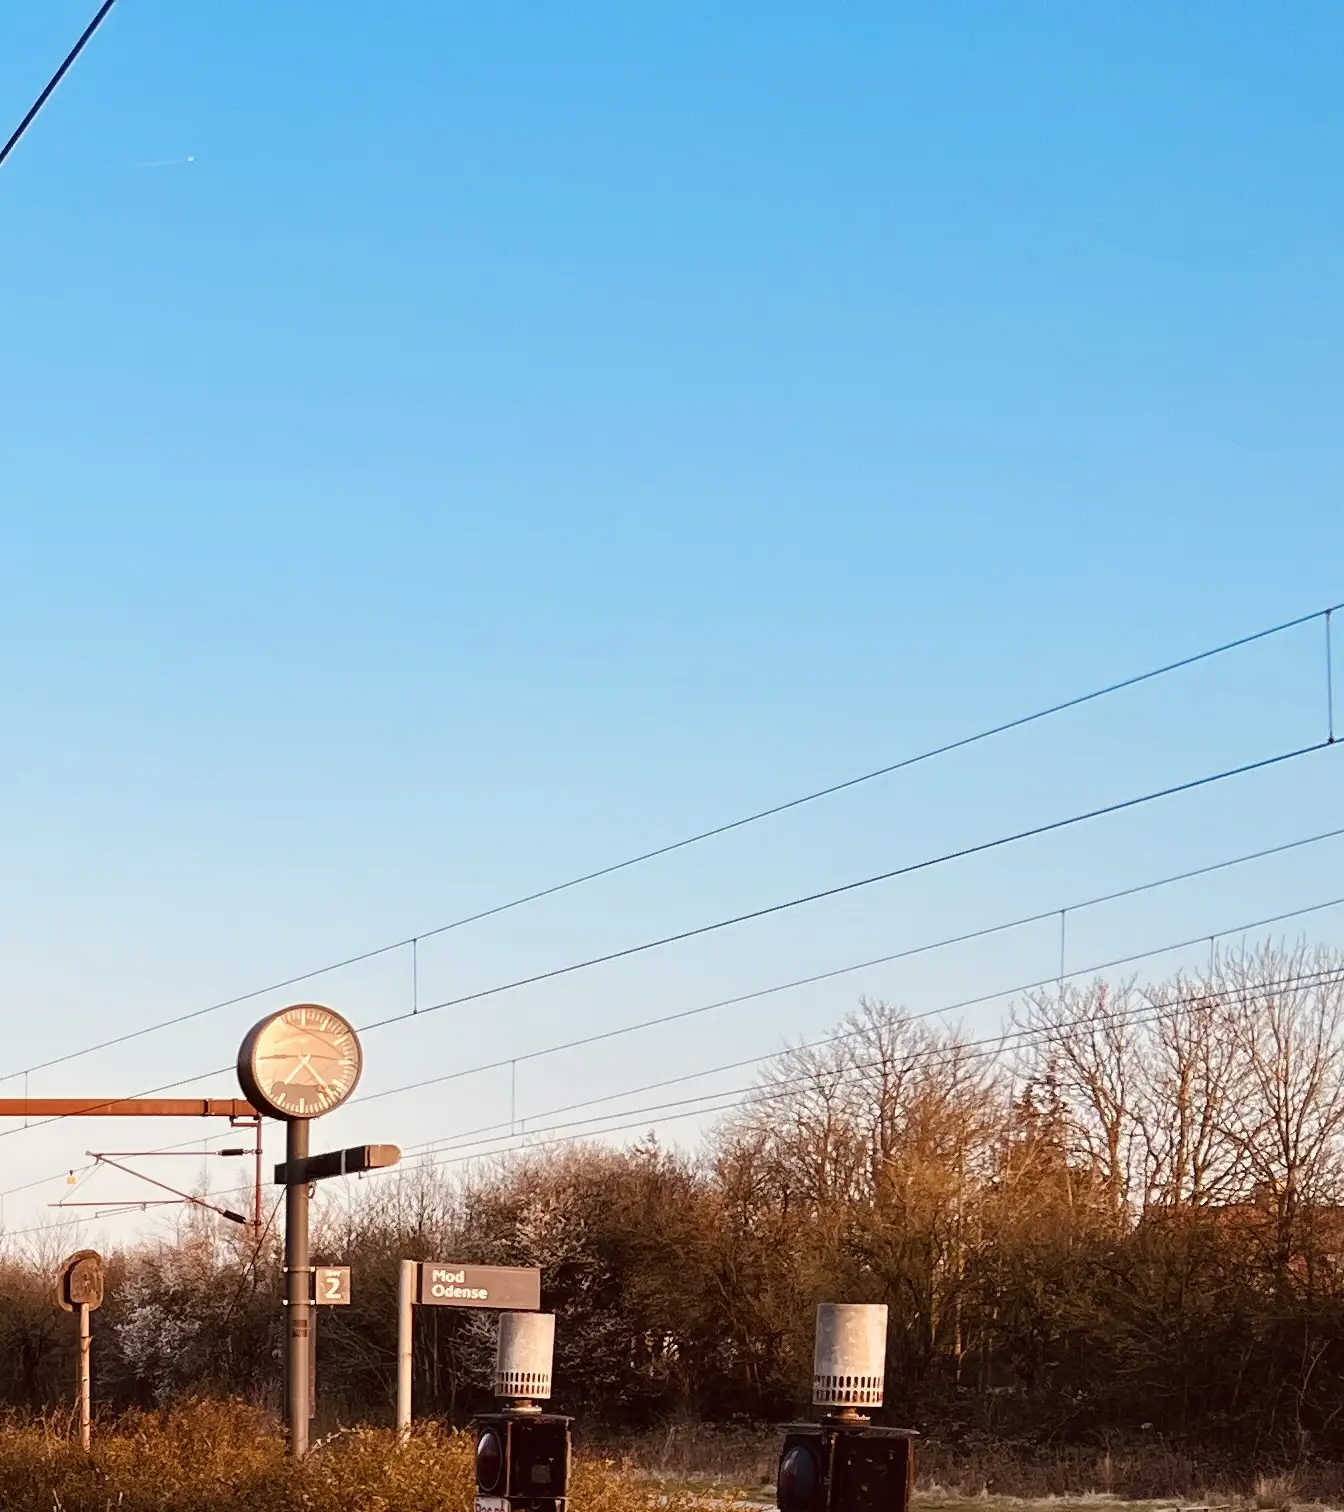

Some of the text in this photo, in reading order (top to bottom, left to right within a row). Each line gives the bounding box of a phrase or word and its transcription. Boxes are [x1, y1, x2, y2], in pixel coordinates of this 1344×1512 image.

[432, 1269, 465, 1284] Mod
[325, 1278, 342, 1299] 2
[432, 1284, 488, 1300] Odense
